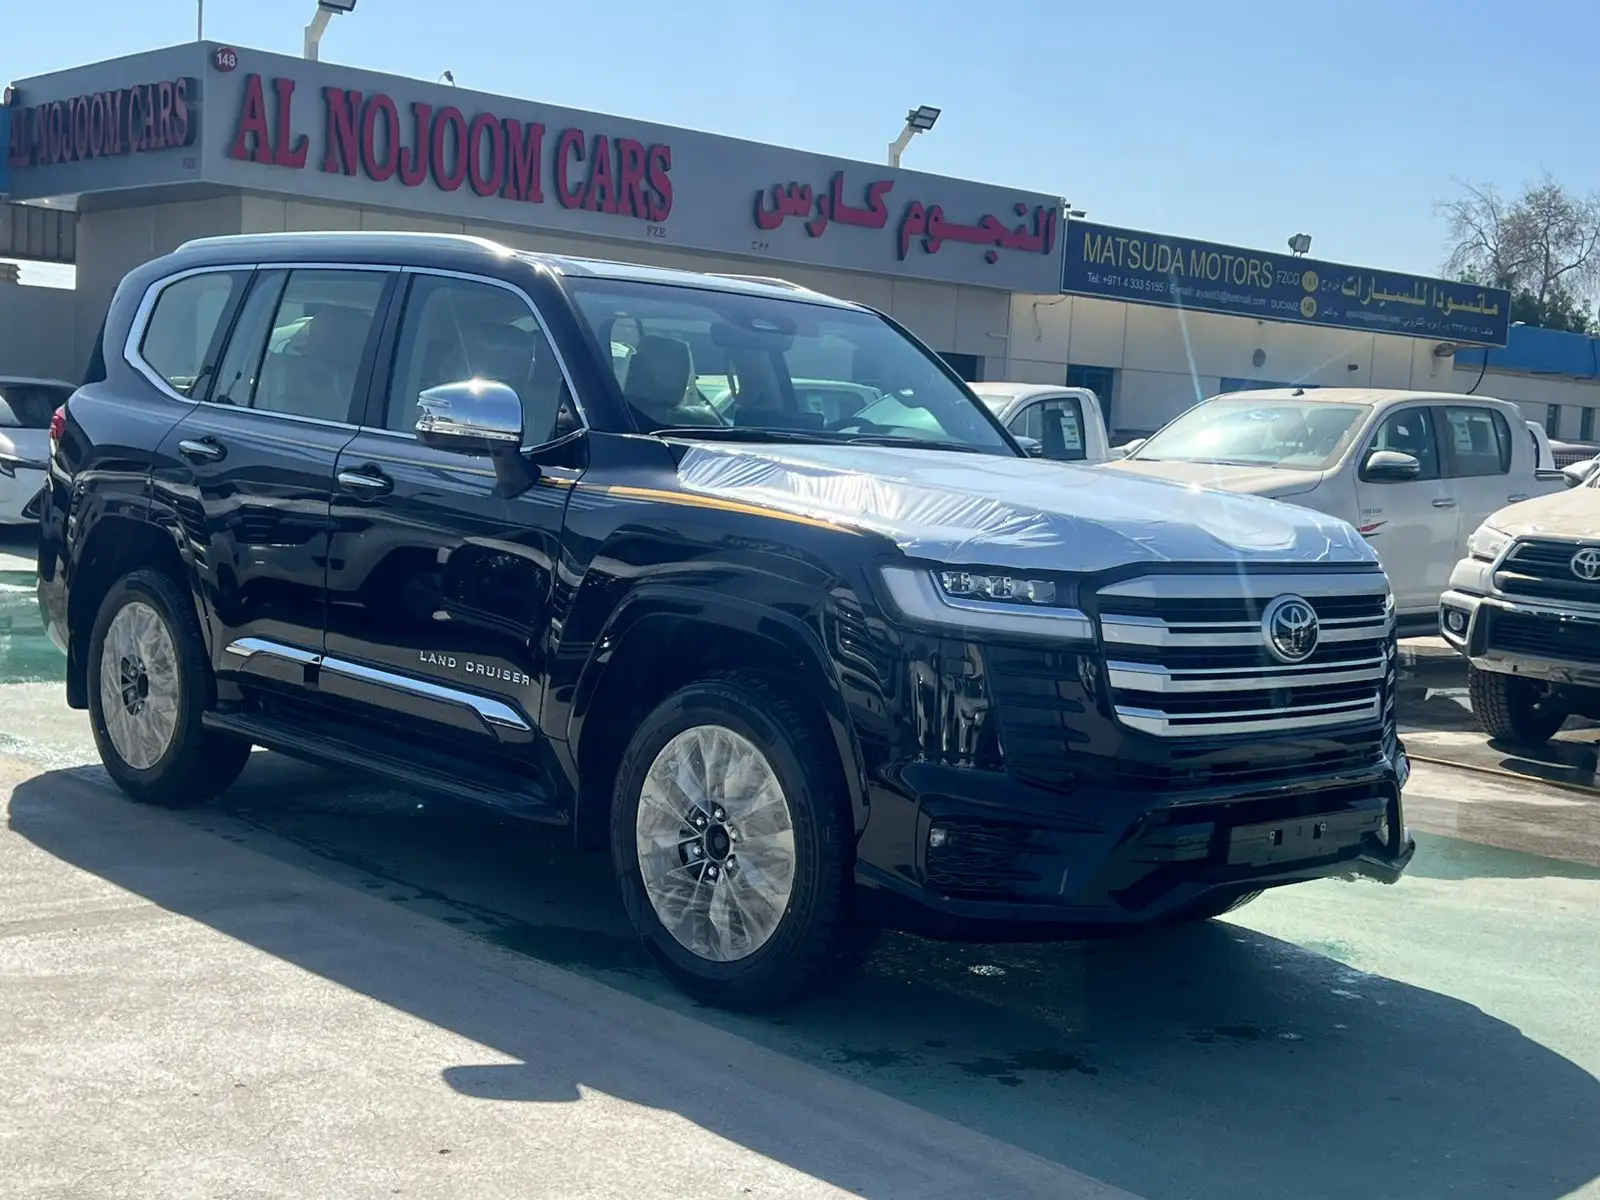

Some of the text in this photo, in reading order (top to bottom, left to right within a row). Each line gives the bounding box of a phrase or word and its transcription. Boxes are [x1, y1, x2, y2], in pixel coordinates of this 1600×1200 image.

[216, 52, 236, 68] 148
[128, 77, 194, 152] CARS
[230, 73, 672, 222] AL NOJOOM CARS
[646, 224, 667, 238] FZE
[753, 170, 1057, 264] النجوم كارس
[1083, 232, 1300, 289] MATSUDA MOTORS FZCO
[1087, 271, 1101, 284] Tel:
[1102, 275, 1121, 287] +971
[1130, 279, 1144, 290] 333
[1145, 280, 1164, 293] 5155
[420, 650, 530, 686] LAND CRUISER
